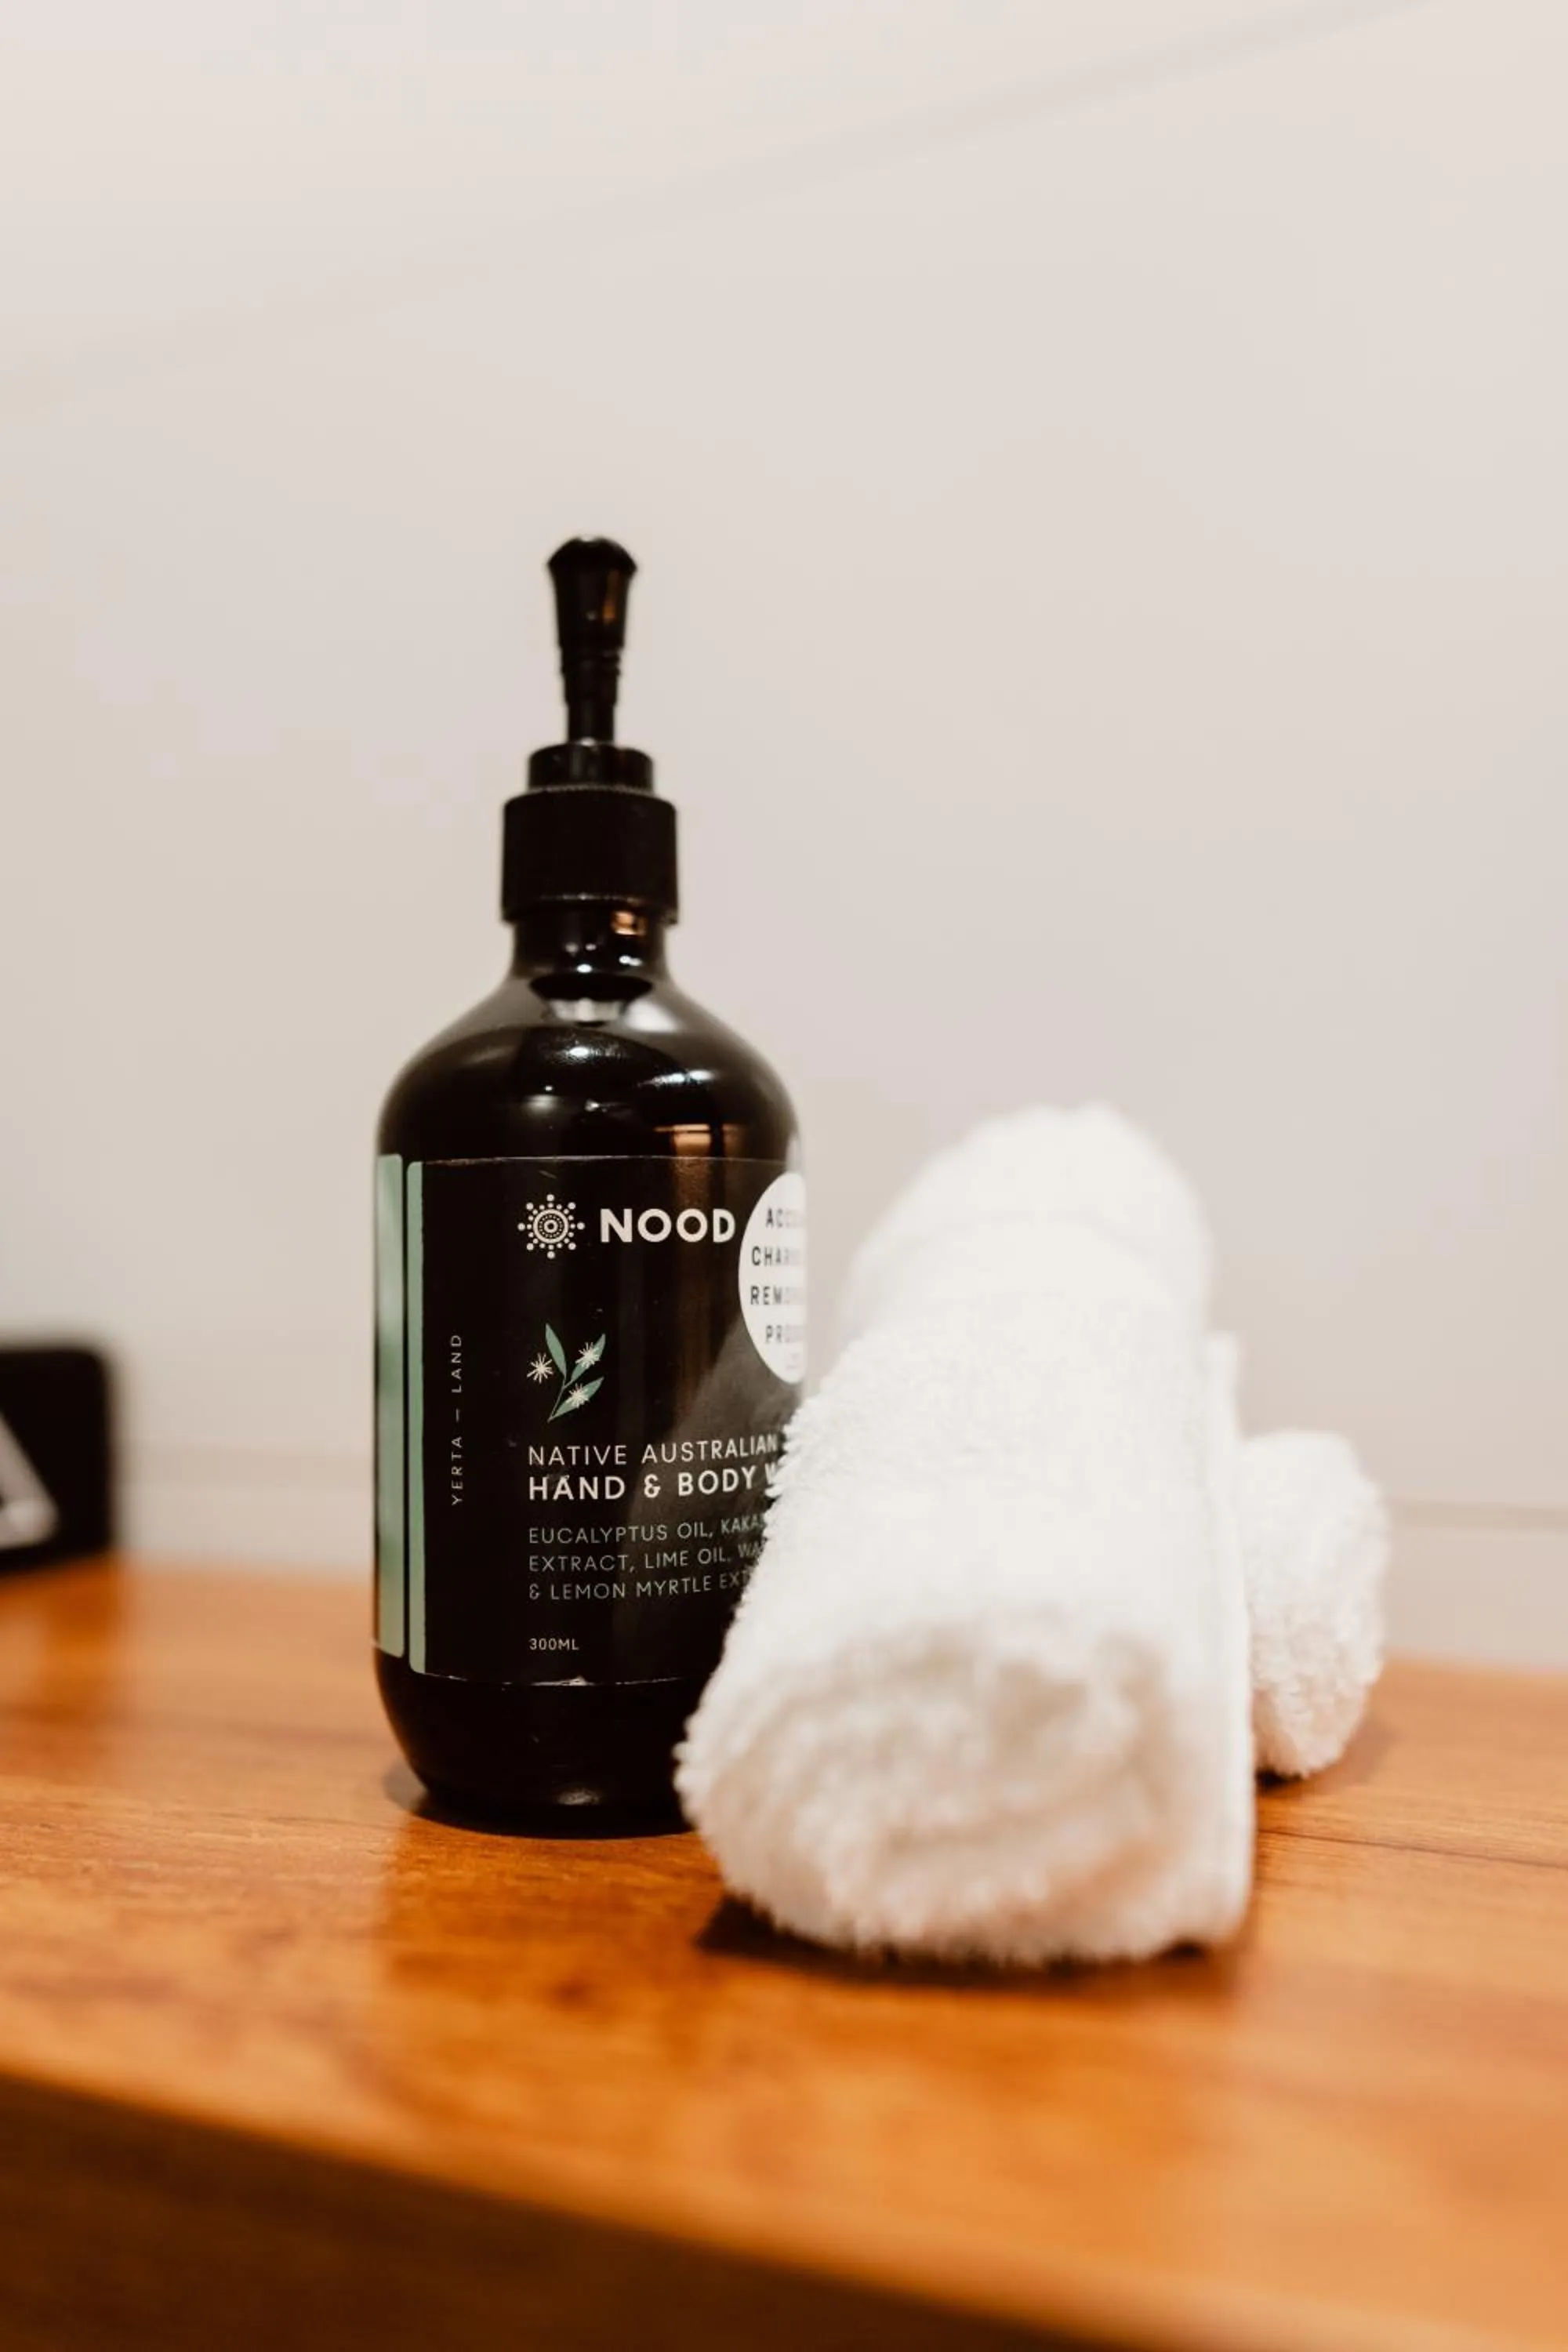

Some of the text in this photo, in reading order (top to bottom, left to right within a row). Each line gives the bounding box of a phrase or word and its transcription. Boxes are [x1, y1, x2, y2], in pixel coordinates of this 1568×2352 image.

[600, 1208, 736, 1243] NOOD
[450, 1334, 463, 1393] LAND
[528, 1433, 778, 1466] NATIVE AUSTRALIAN
[451, 1436, 463, 1506] YERTA
[528, 1476, 626, 1501] HAND
[644, 1473, 661, 1498] &
[677, 1465, 757, 1497] BODY
[528, 1524, 668, 1544] EUCALYPTUS
[677, 1521, 713, 1540] OIL,
[528, 1555, 636, 1573] EXTRACT,
[644, 1550, 690, 1570] LIME
[528, 1582, 542, 1601] &
[550, 1582, 626, 1601] LEMON
[636, 1574, 713, 1599] MYRTLE
[528, 1638, 580, 1652] 300ML
